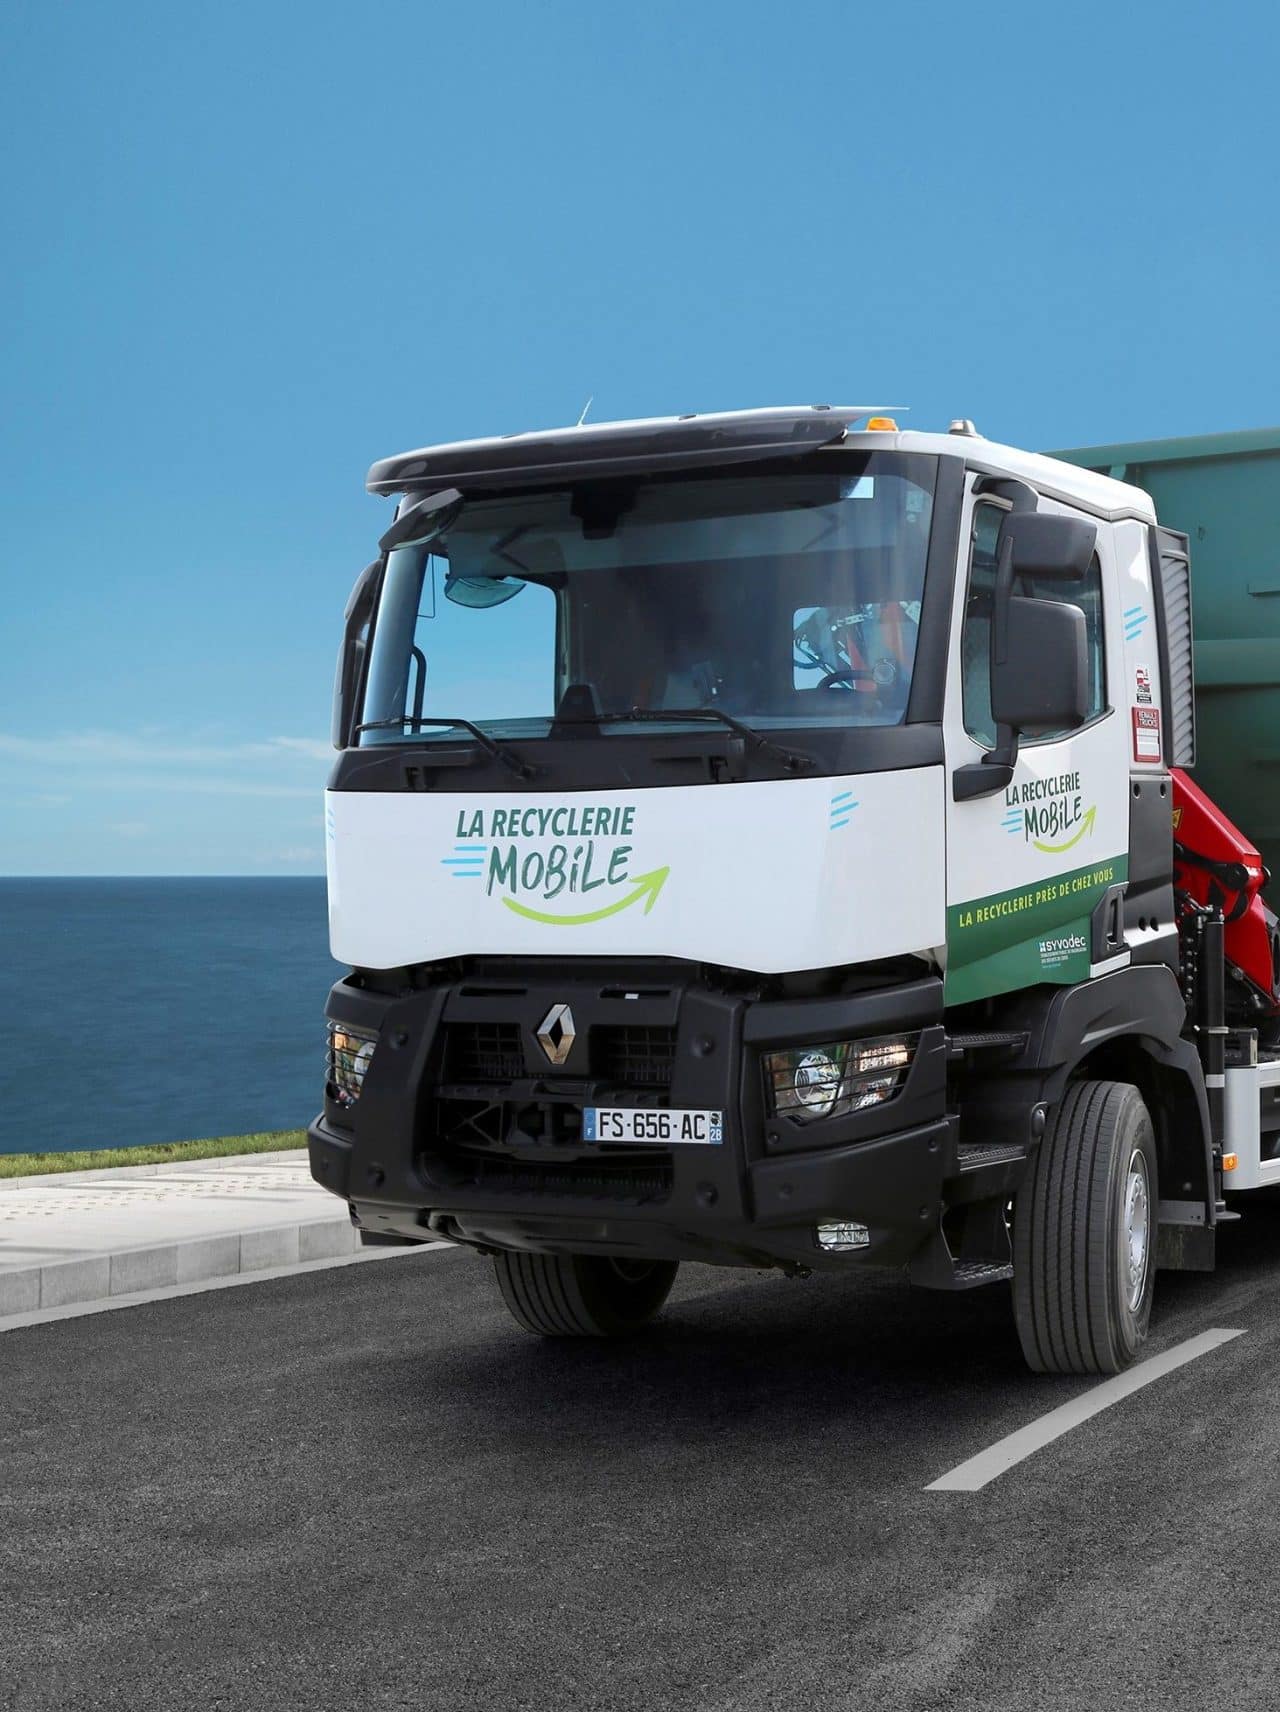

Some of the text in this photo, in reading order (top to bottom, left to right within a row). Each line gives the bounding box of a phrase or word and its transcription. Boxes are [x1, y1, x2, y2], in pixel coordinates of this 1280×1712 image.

[1006, 772, 1080, 806] LA RECYCLERIE
[456, 807, 636, 837] LA RECYCLERIE
[959, 868, 1113, 928] LA RECYCLERIE PRÈS DE CHEZ VOUS
[1046, 933, 1086, 951] syvadec
[710, 1128, 722, 1141] 2B
